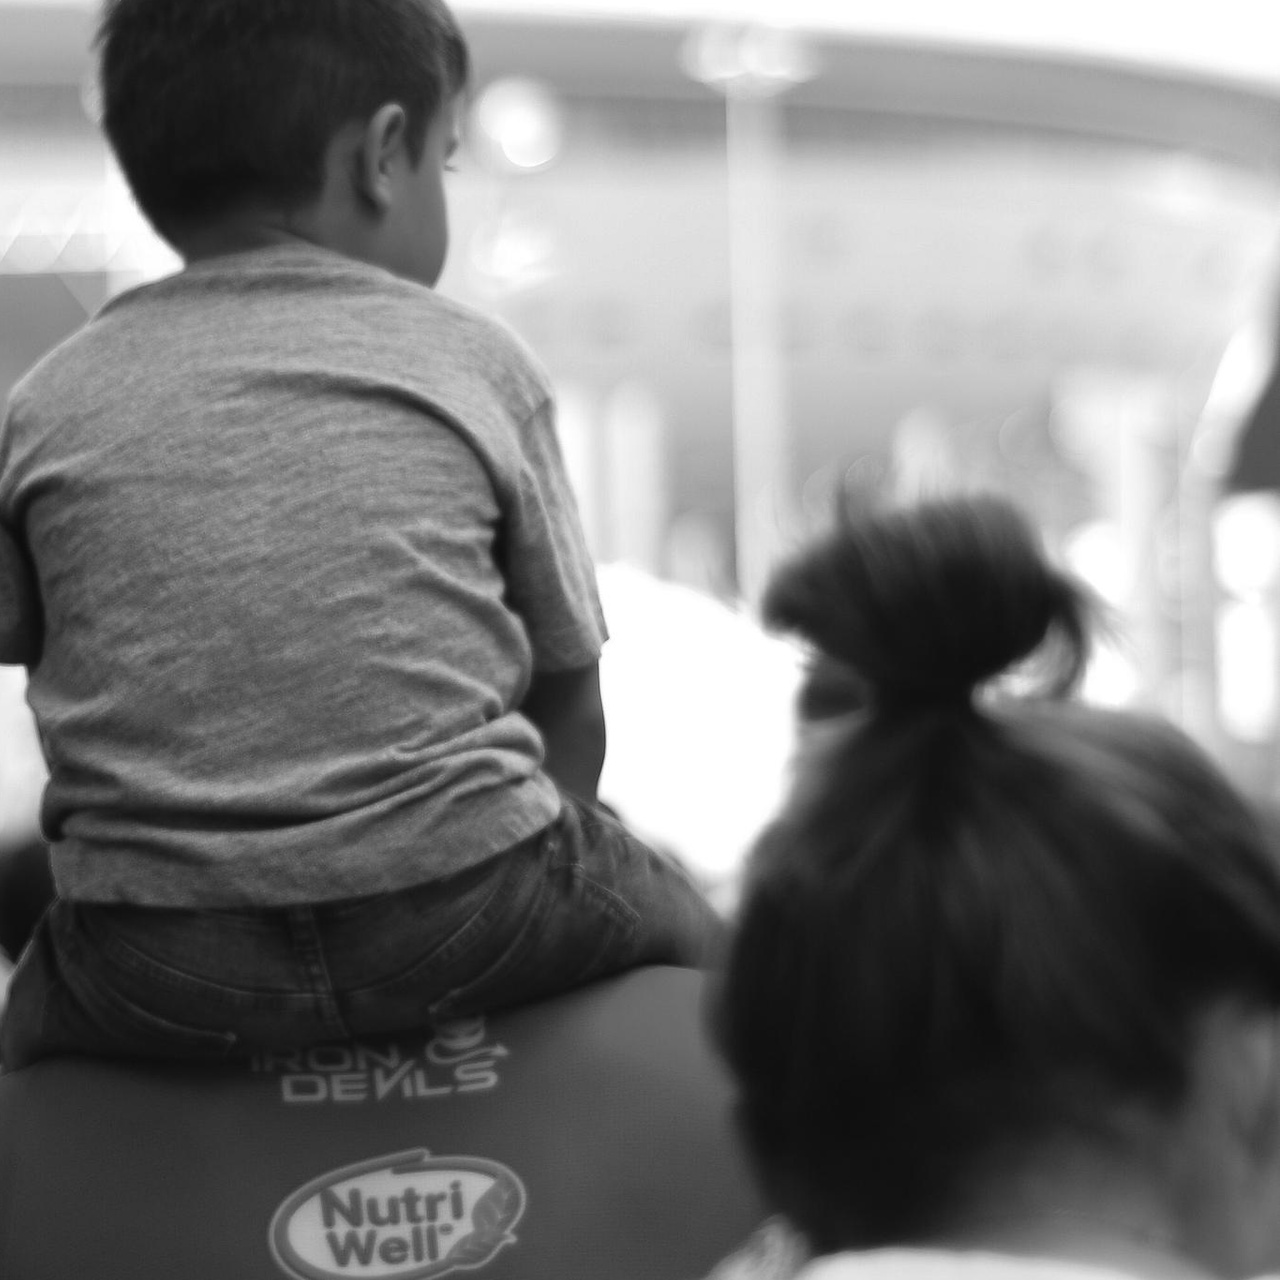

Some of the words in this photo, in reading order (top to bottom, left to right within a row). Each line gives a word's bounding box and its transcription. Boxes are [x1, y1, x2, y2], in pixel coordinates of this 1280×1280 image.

[281, 1061, 498, 1103] DEVILS
[320, 1180, 463, 1229] Nutri
[326, 1224, 440, 1268] Well
